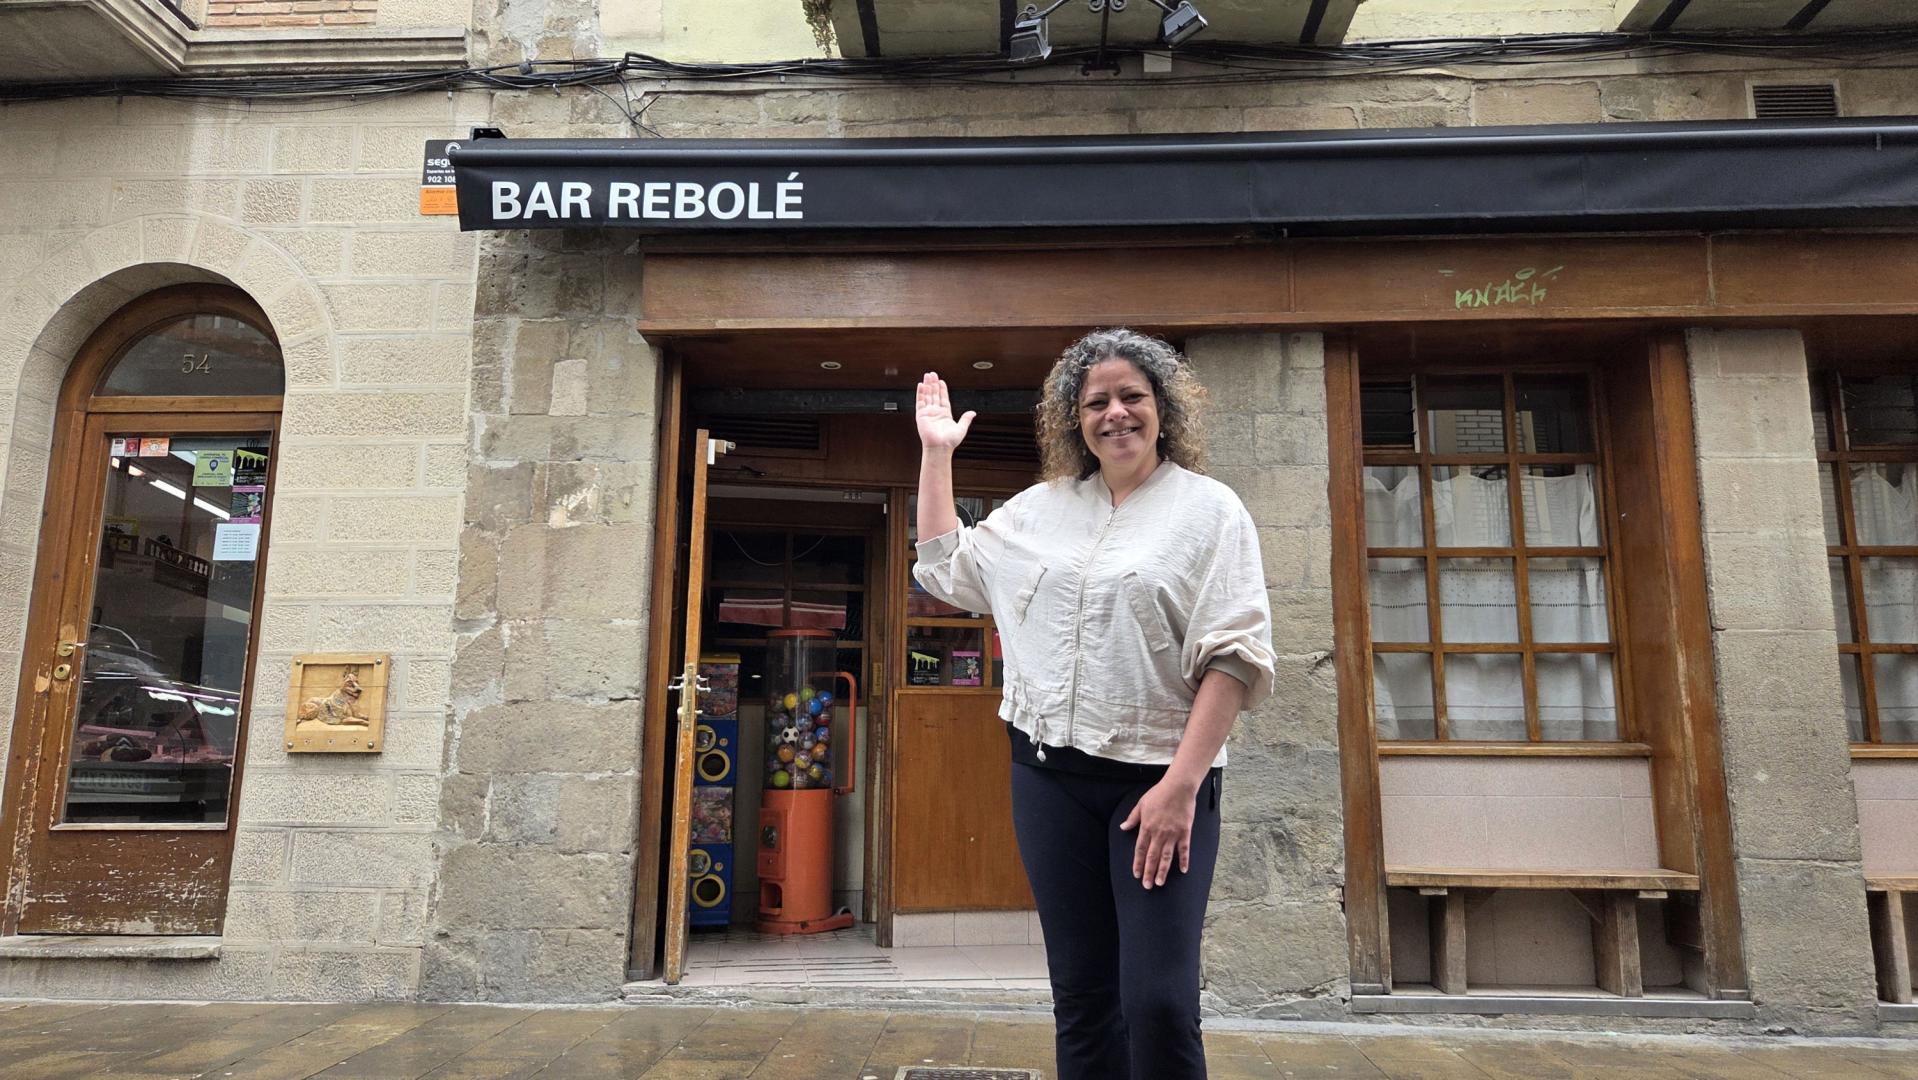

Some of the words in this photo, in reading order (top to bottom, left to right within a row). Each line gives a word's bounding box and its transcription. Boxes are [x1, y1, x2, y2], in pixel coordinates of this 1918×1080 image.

[427, 175, 442, 183] 902
[492, 181, 592, 219] BAR
[608, 172, 804, 219] REBOLÉ
[182, 354, 211, 374] 54
